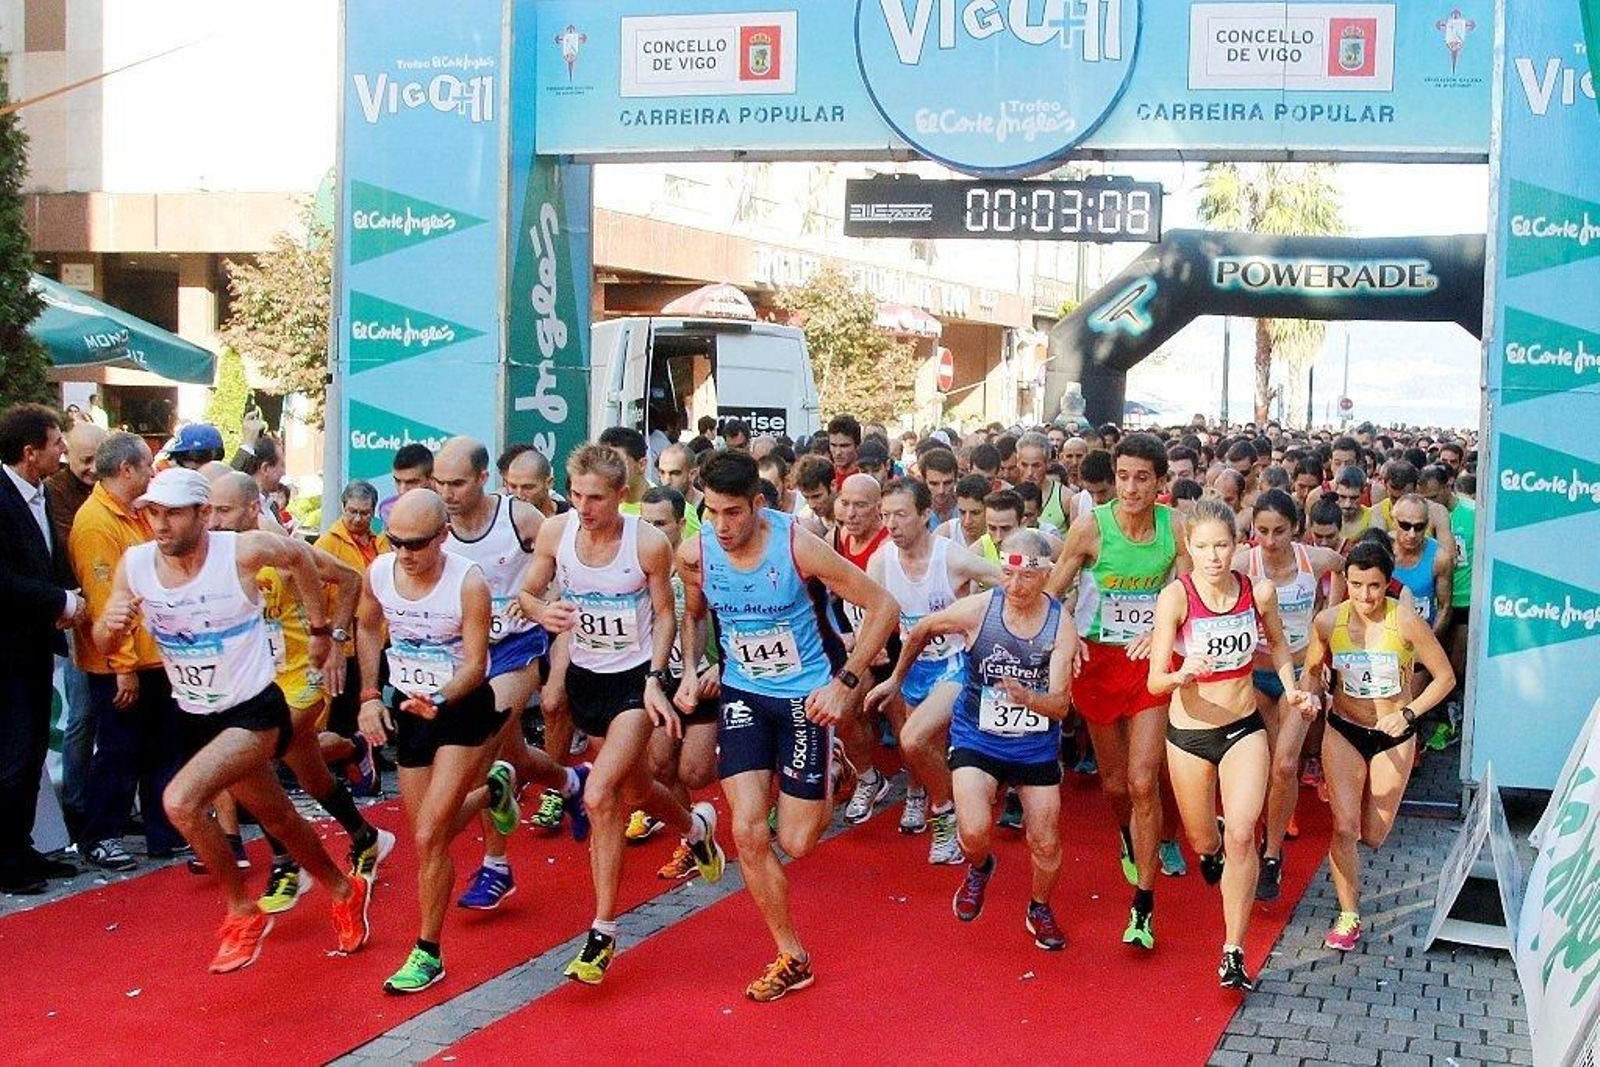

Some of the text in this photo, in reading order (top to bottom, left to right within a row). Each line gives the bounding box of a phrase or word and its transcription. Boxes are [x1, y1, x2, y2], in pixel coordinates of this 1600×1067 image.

[643, 39, 727, 54] CONCELLO
[1216, 29, 1314, 45] CONCELLO
[653, 56, 717, 71] DE VIGO
[1227, 48, 1302, 62] DE VIGO
[620, 105, 845, 127] CARREIRA POPULAR
[1008, 100, 1062, 113] Trofeo
[1136, 103, 1395, 123] CARREIRA POPULAR
[914, 108, 938, 133] El
[939, 108, 994, 134] Corte
[353, 210, 369, 229] El
[369, 211, 403, 229] Corte
[966, 188, 1151, 235] 00:03:08
[1511, 215, 1531, 237] El
[1532, 216, 1579, 238] Corte
[352, 321, 368, 339] El
[368, 322, 403, 339] Corte
[1505, 341, 1524, 364] El
[1527, 344, 1572, 367] Corte
[351, 429, 366, 449] El
[367, 431, 402, 450] Corte
[1501, 469, 1521, 491] El
[1521, 471, 1567, 494] Corte
[1114, 609, 1155, 624] 102
[1494, 595, 1514, 617] El
[1514, 597, 1560, 620] Corte
[580, 613, 628, 636] 811
[738, 641, 788, 663] 144
[1207, 632, 1252, 656] 890
[173, 664, 216, 687] 187
[400, 667, 439, 688] 101
[1361, 671, 1373, 684] 4
[994, 705, 1040, 727] 375
